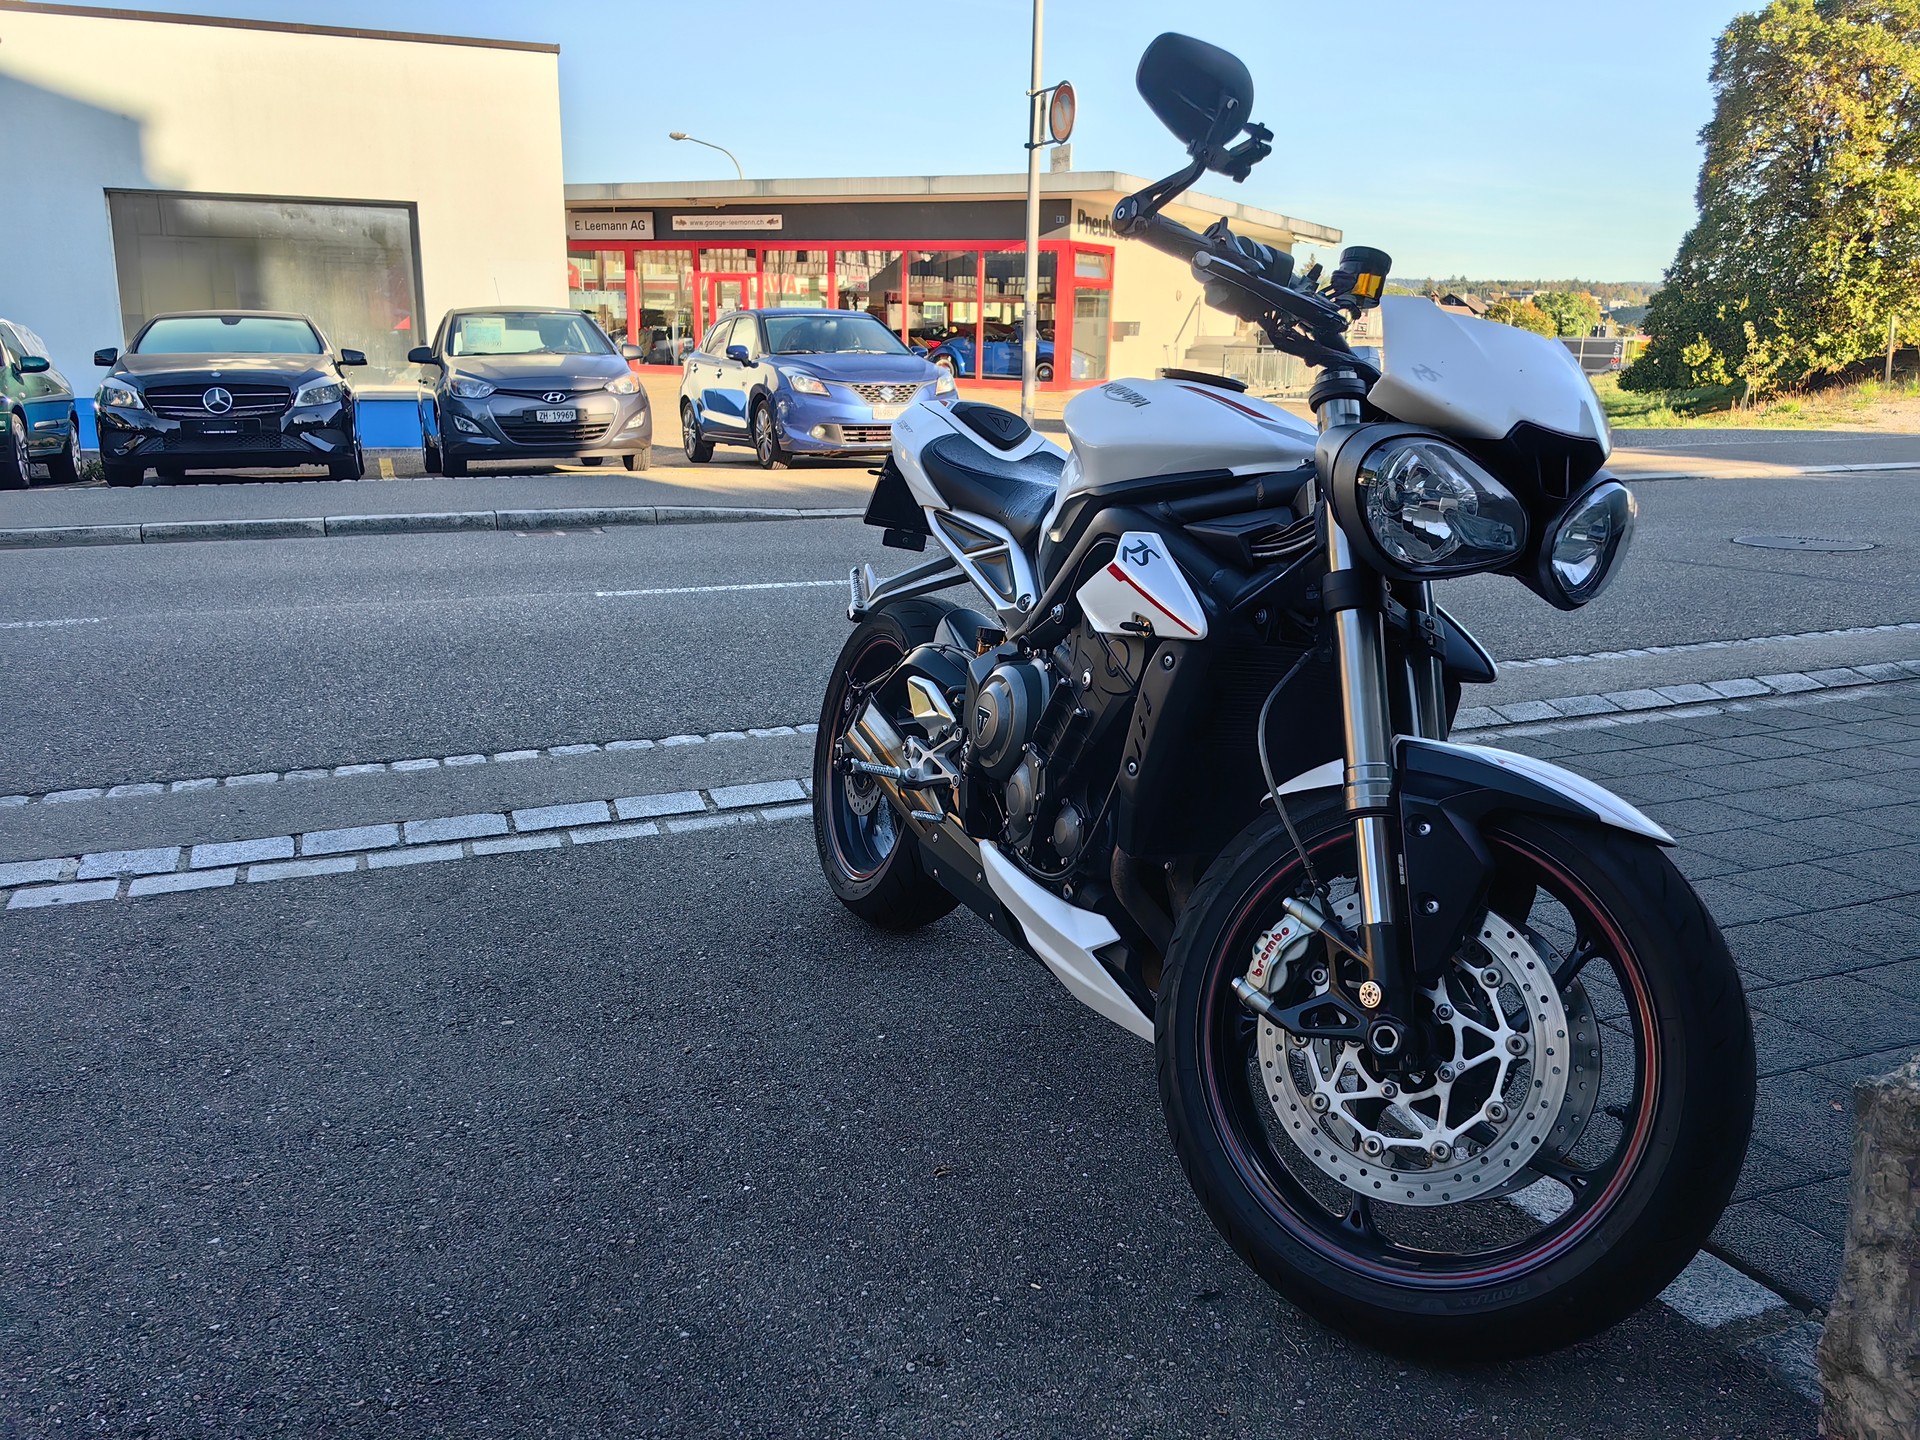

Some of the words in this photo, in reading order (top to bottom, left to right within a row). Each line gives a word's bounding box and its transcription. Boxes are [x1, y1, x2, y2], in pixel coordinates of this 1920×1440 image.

[574, 220, 583, 231] E.
[585, 220, 628, 231] Leemann
[630, 219, 646, 231] AG
[689, 219, 765, 228] www.garage-leemann.ch
[539, 411, 549, 420] ZH
[552, 410, 574, 420] 19969
[1251, 926, 1290, 977] brembo
